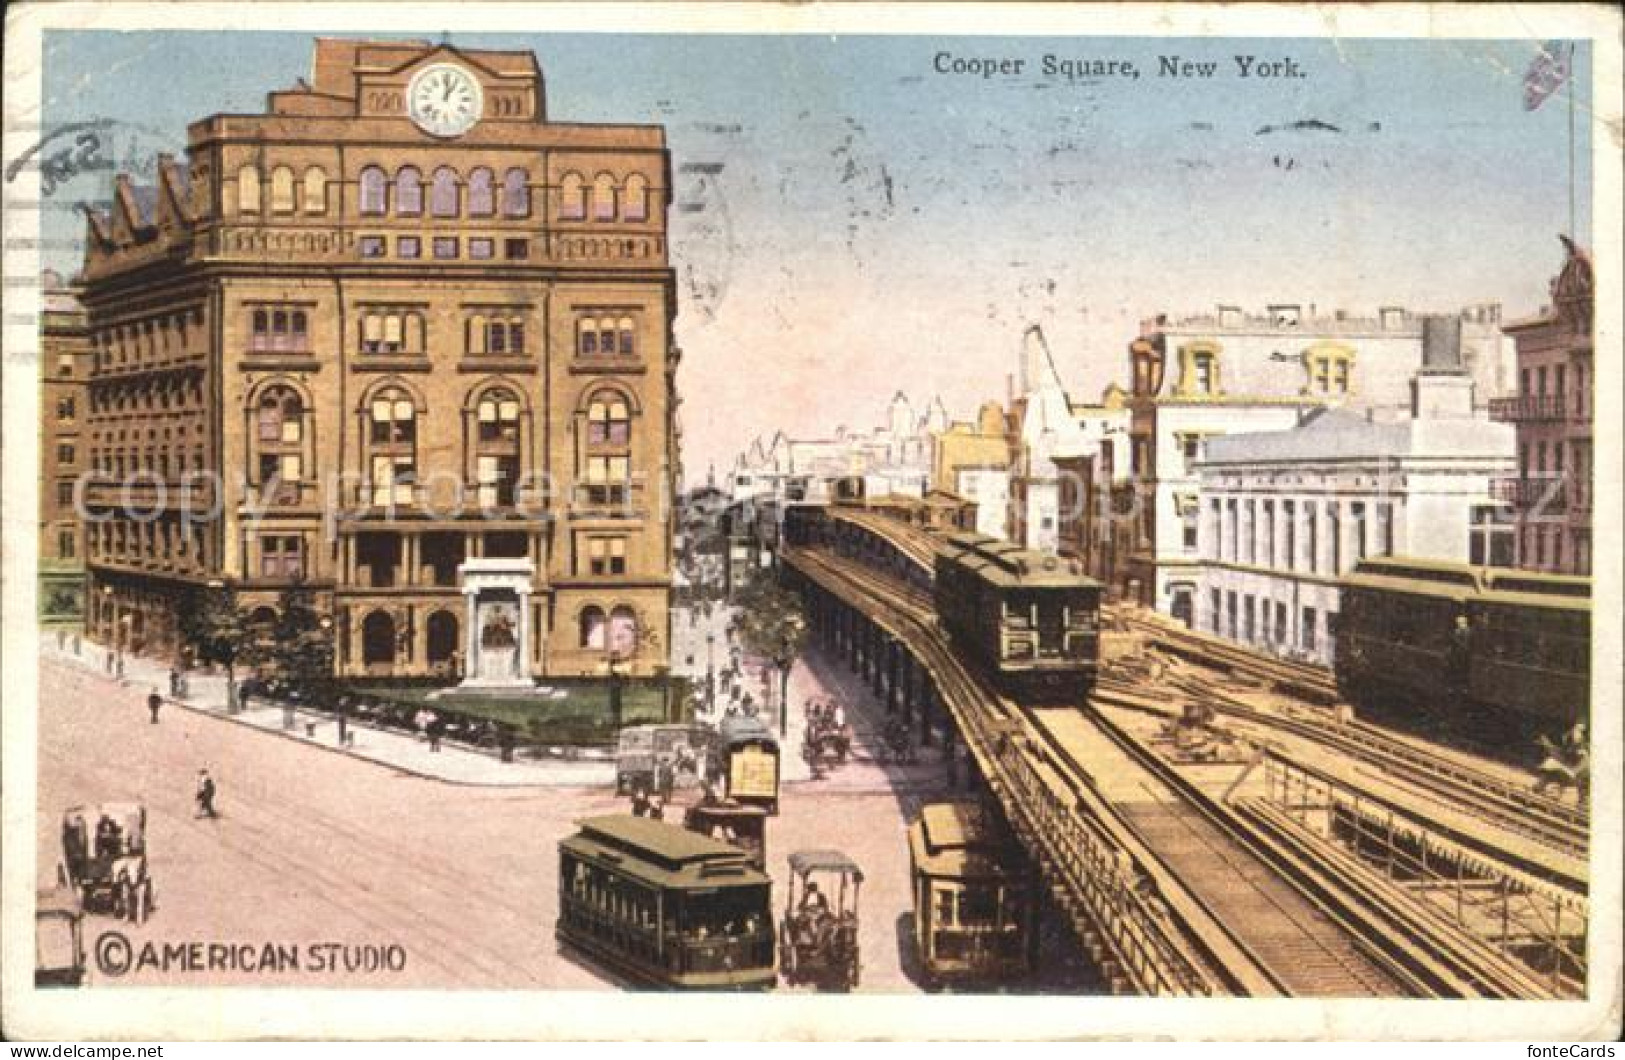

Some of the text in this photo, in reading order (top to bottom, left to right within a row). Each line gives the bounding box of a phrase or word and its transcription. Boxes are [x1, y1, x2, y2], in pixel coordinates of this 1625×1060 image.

[933, 52, 1307, 80] Cooper Square, New York.
[308, 943, 408, 974] STUDIO
